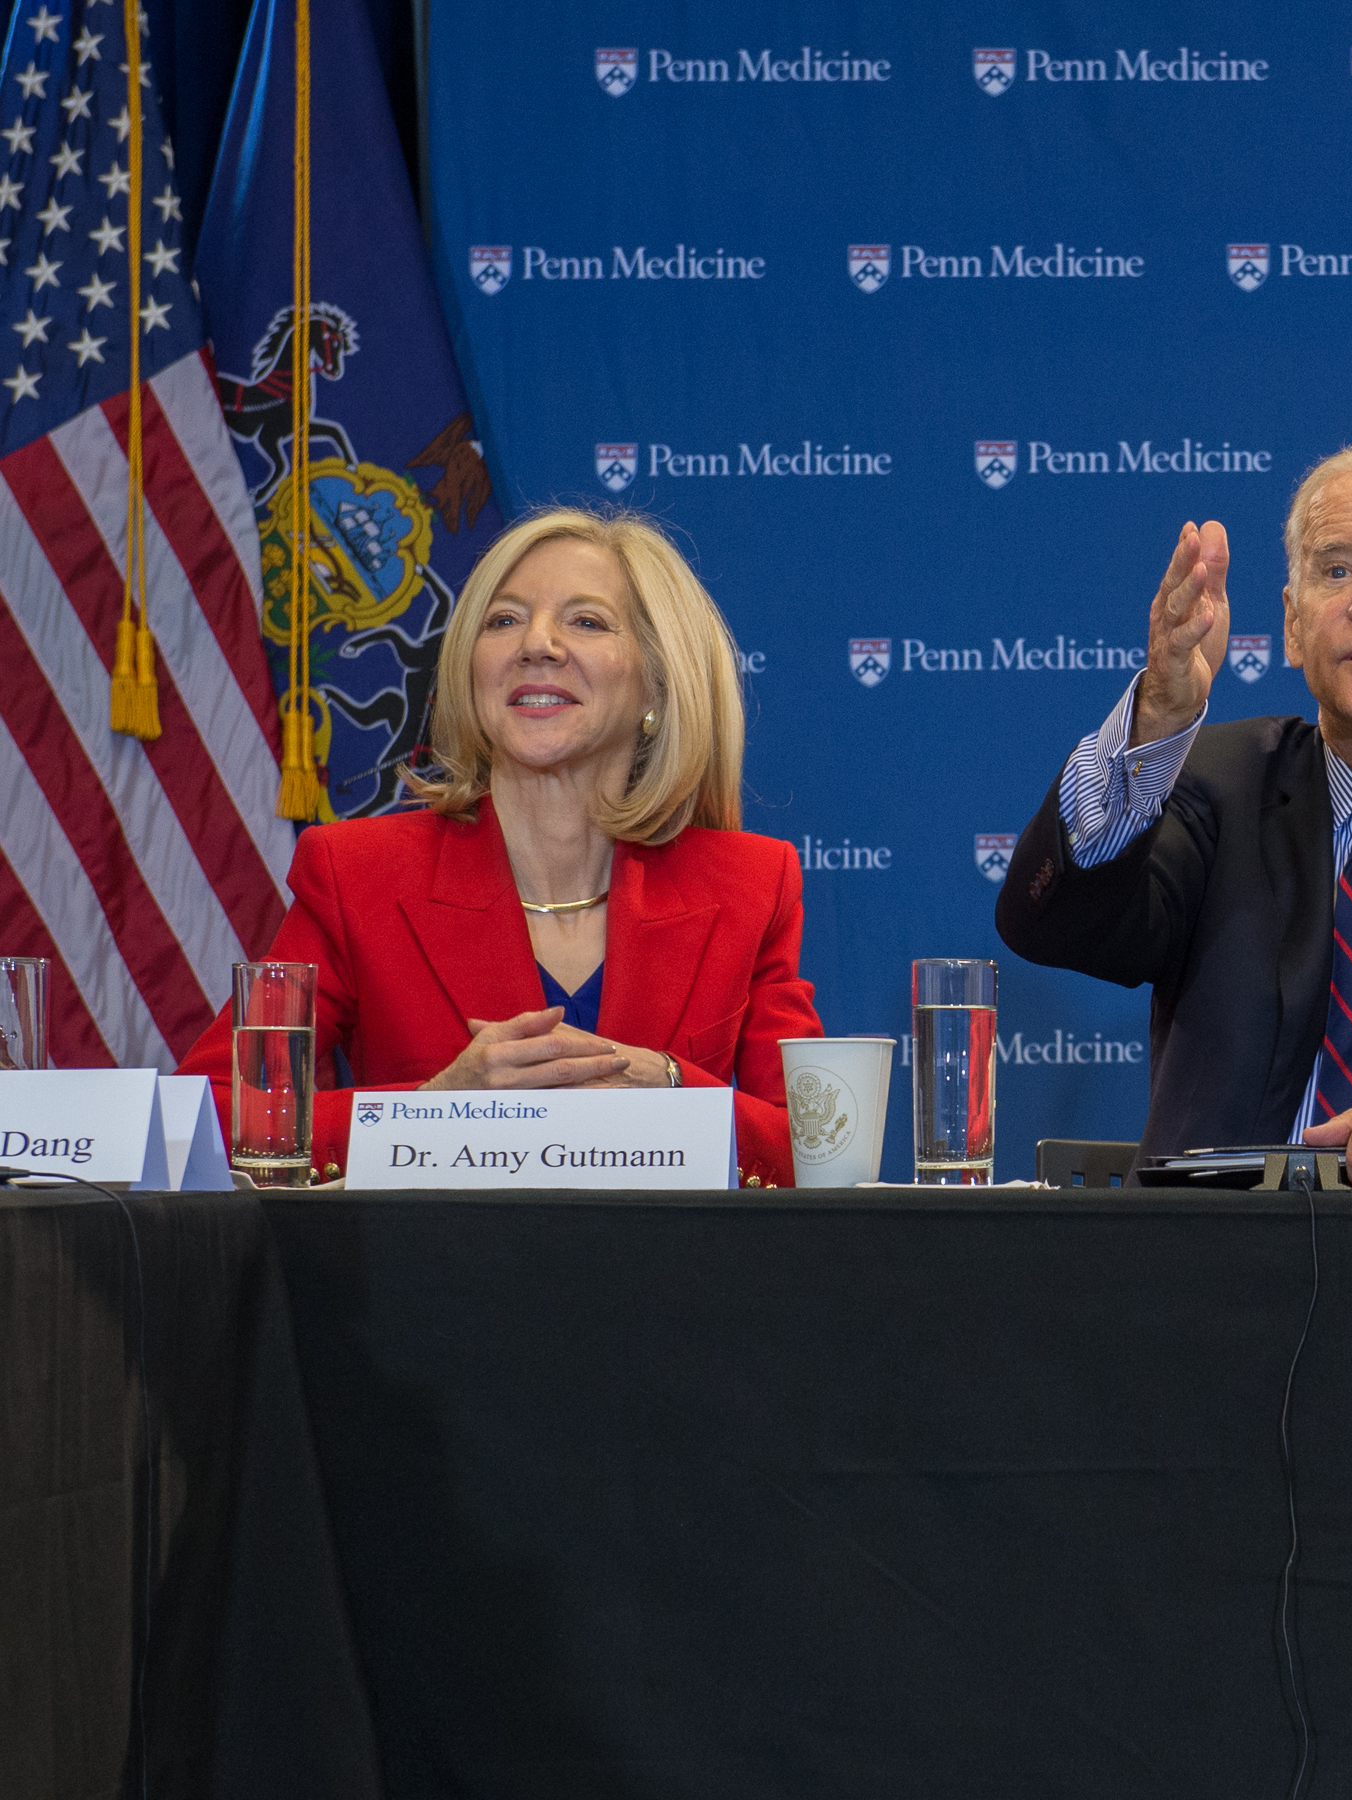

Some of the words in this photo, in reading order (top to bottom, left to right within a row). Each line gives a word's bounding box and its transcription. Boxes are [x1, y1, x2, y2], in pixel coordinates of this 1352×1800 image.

[649, 48, 730, 82] Penn
[736, 46, 891, 82] Medicine
[1026, 49, 1107, 82] Penn
[1114, 45, 1269, 81] Medicine
[523, 246, 604, 280] Penn
[611, 243, 766, 280] Medicine
[902, 245, 982, 278] Penn
[989, 242, 1145, 278] Medicine
[649, 444, 730, 477] Penn
[737, 440, 892, 476] Medicine
[1028, 440, 1110, 474] Penn
[1117, 437, 1272, 473] Medicine
[902, 638, 983, 672] Penn
[991, 633, 1147, 671] Medicine
[797, 834, 892, 870] dicine
[997, 1028, 1146, 1065] Medicine
[391, 1101, 443, 1120] Penn
[447, 1100, 548, 1120] Medicine
[0, 1131, 95, 1164] Dang
[389, 1144, 438, 1168] Dr.
[450, 1144, 530, 1175] Amy
[540, 1143, 686, 1168] Gutmann
[828, 1131, 851, 1155] AMERICA
